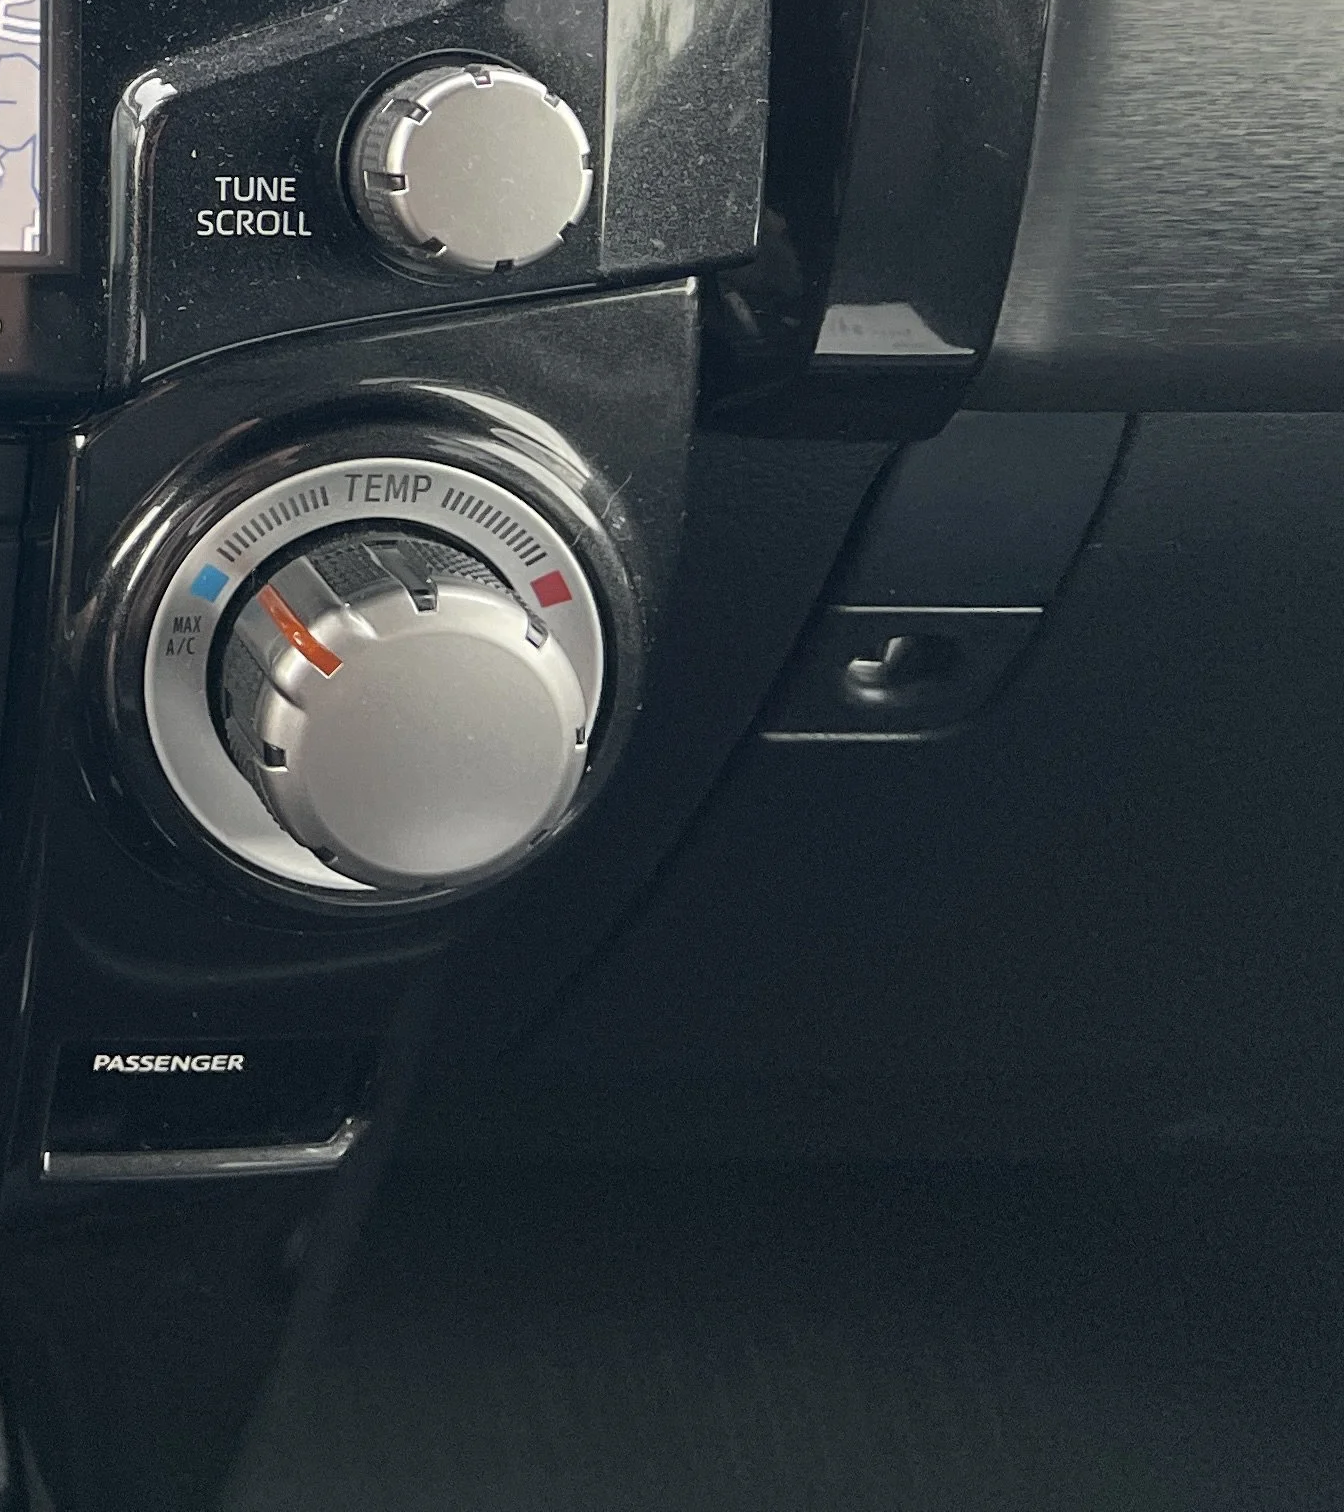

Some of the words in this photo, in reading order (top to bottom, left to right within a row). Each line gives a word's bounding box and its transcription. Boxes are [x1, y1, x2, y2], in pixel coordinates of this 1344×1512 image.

[215, 176, 296, 202] TUNE
[197, 210, 312, 236] SCROLL
[344, 474, 432, 505] TEMP
[173, 615, 201, 634] MAX
[166, 635, 195, 655] A/C
[93, 1054, 245, 1072] PASSENGER
